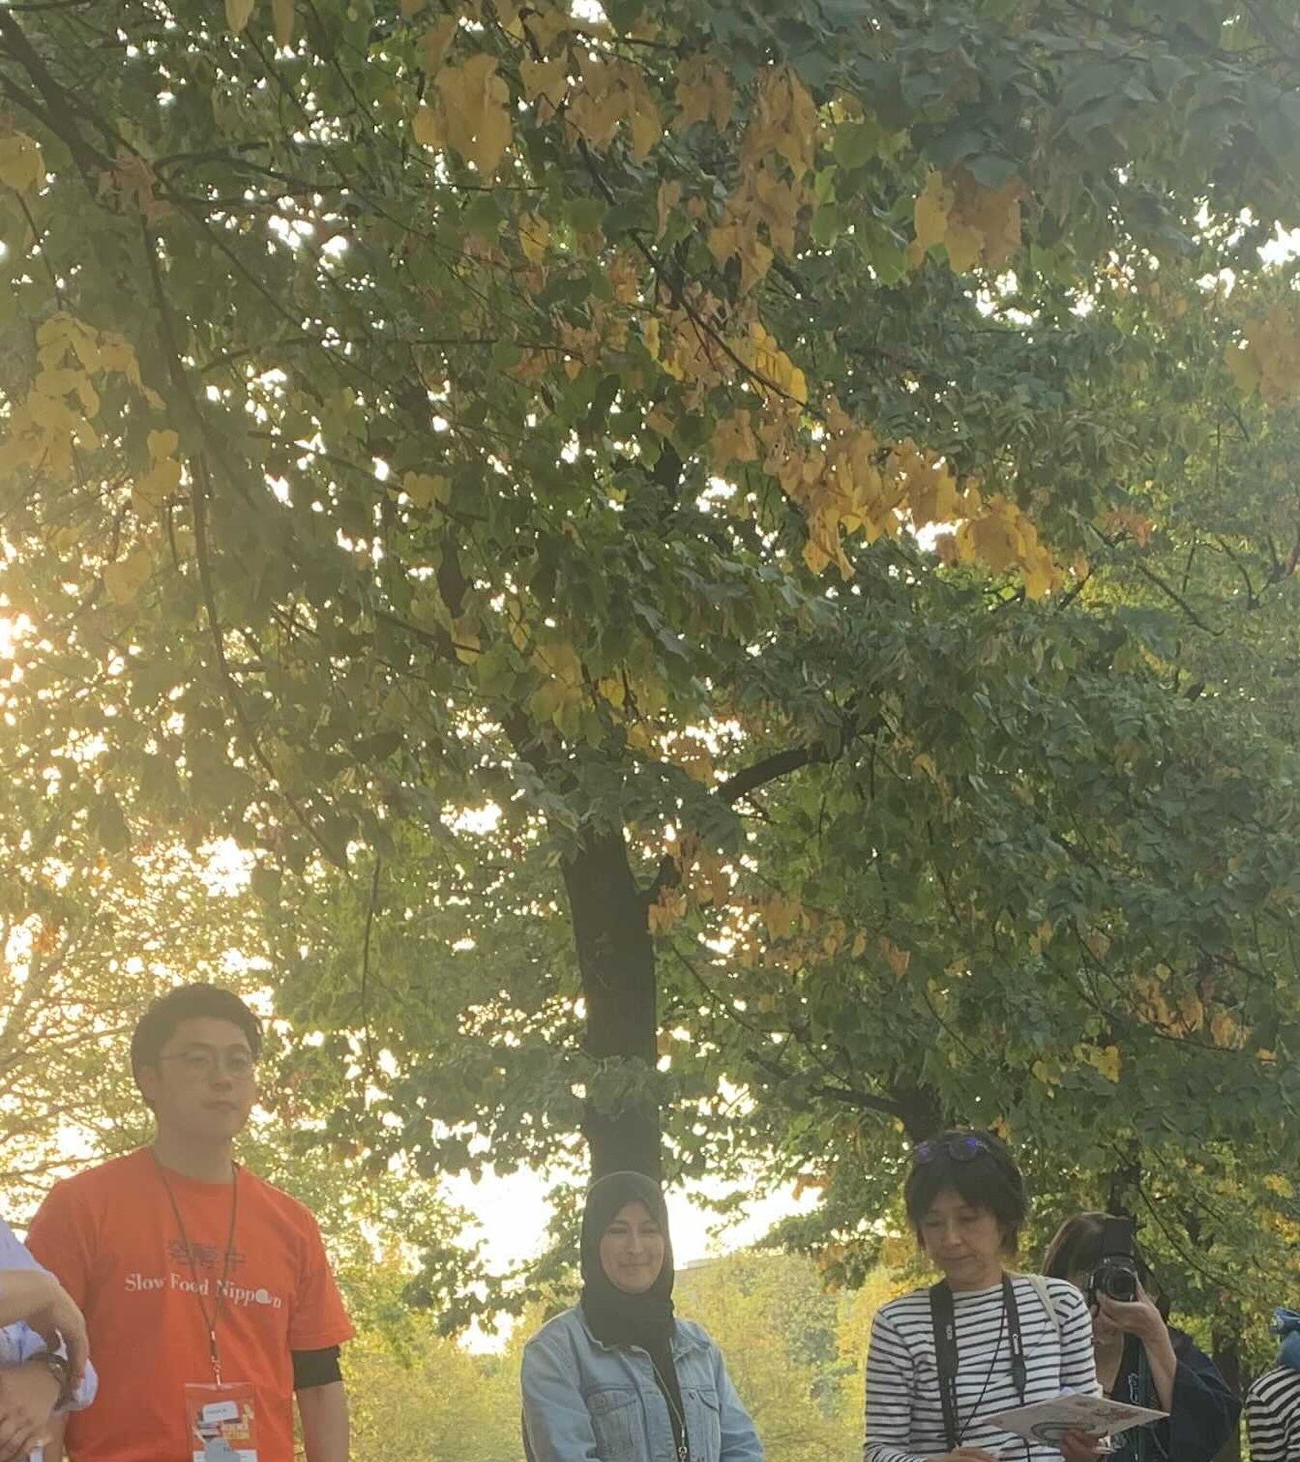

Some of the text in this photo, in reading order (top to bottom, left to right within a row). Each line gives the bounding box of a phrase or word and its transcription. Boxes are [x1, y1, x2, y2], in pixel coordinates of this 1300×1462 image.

[124, 1273, 282, 1309] Slow Food Nippon
